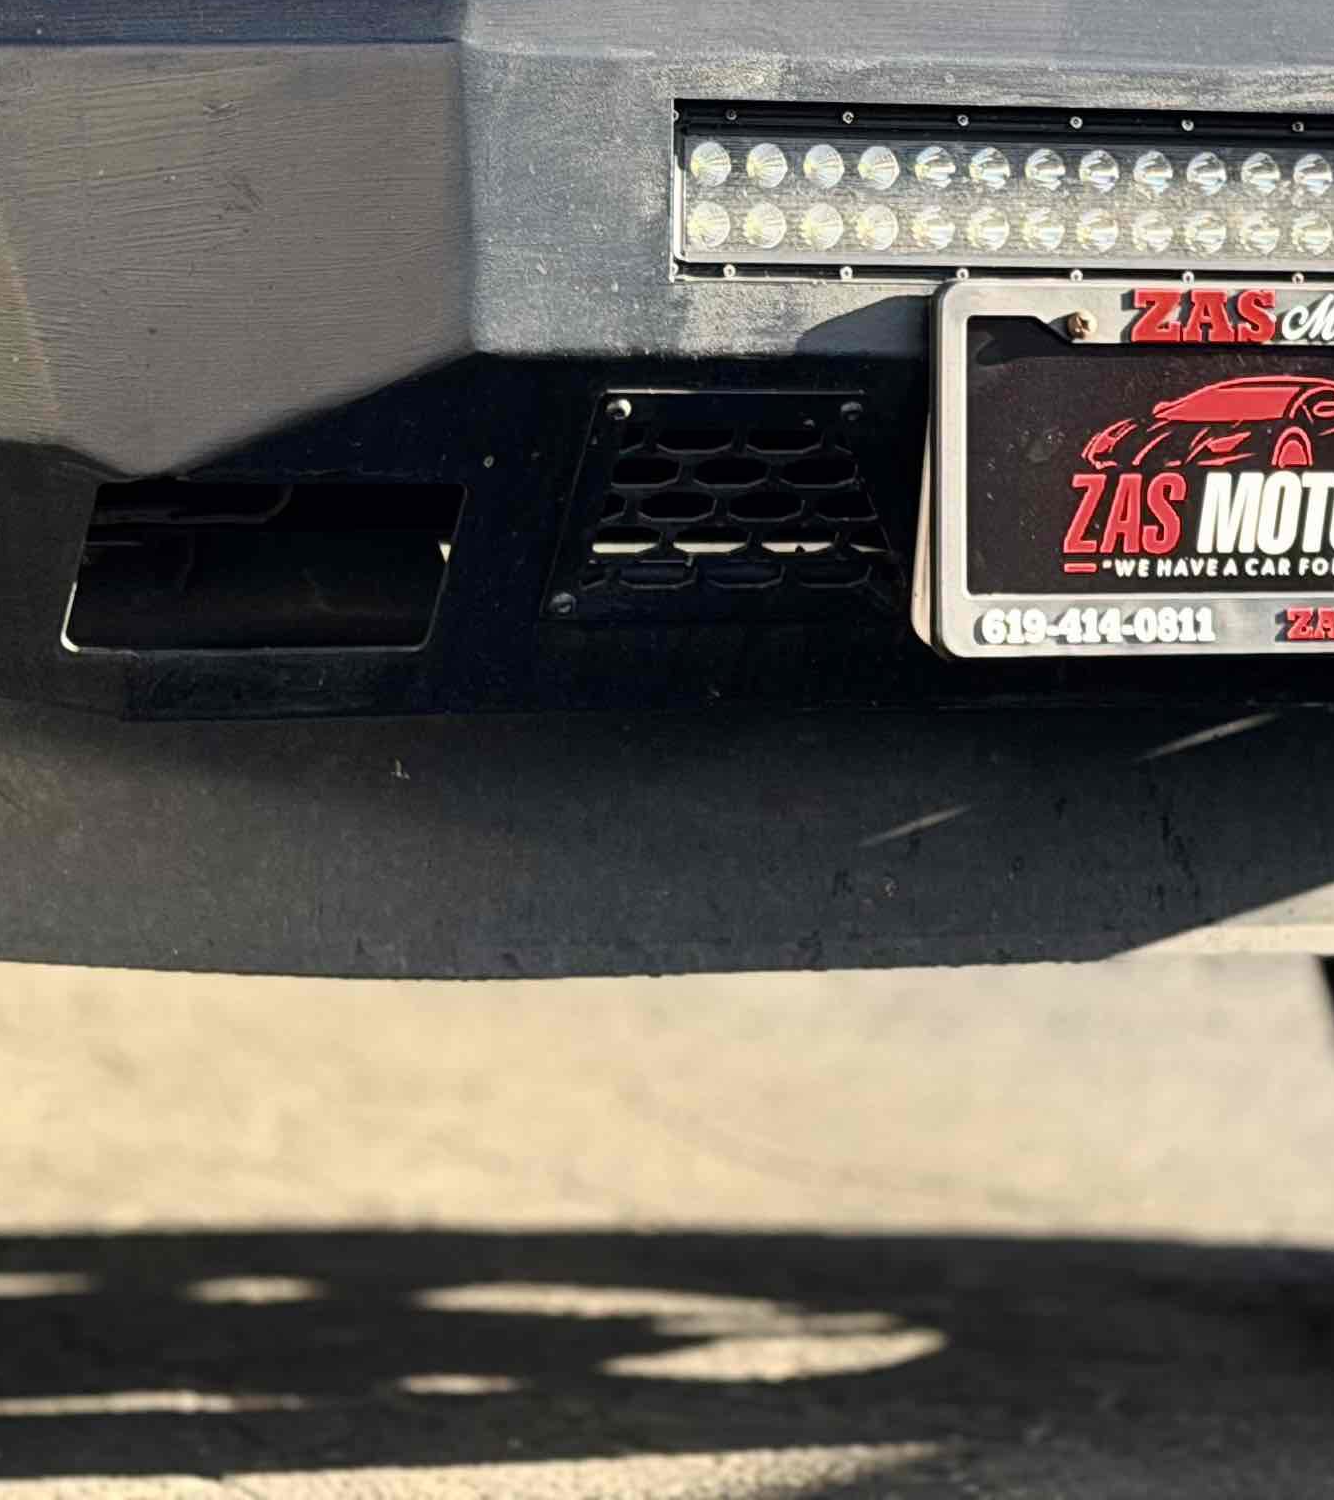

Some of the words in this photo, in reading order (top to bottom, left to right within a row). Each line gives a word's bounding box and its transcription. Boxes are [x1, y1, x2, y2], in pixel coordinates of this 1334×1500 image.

[1131, 288, 1276, 342] ZAS
[1063, 472, 1187, 554] ZAS
[1156, 557, 1218, 578] HAVE
[1222, 557, 1238, 577] A
[1244, 557, 1291, 577] CAR
[980, 607, 1216, 645] 619-414-0811
